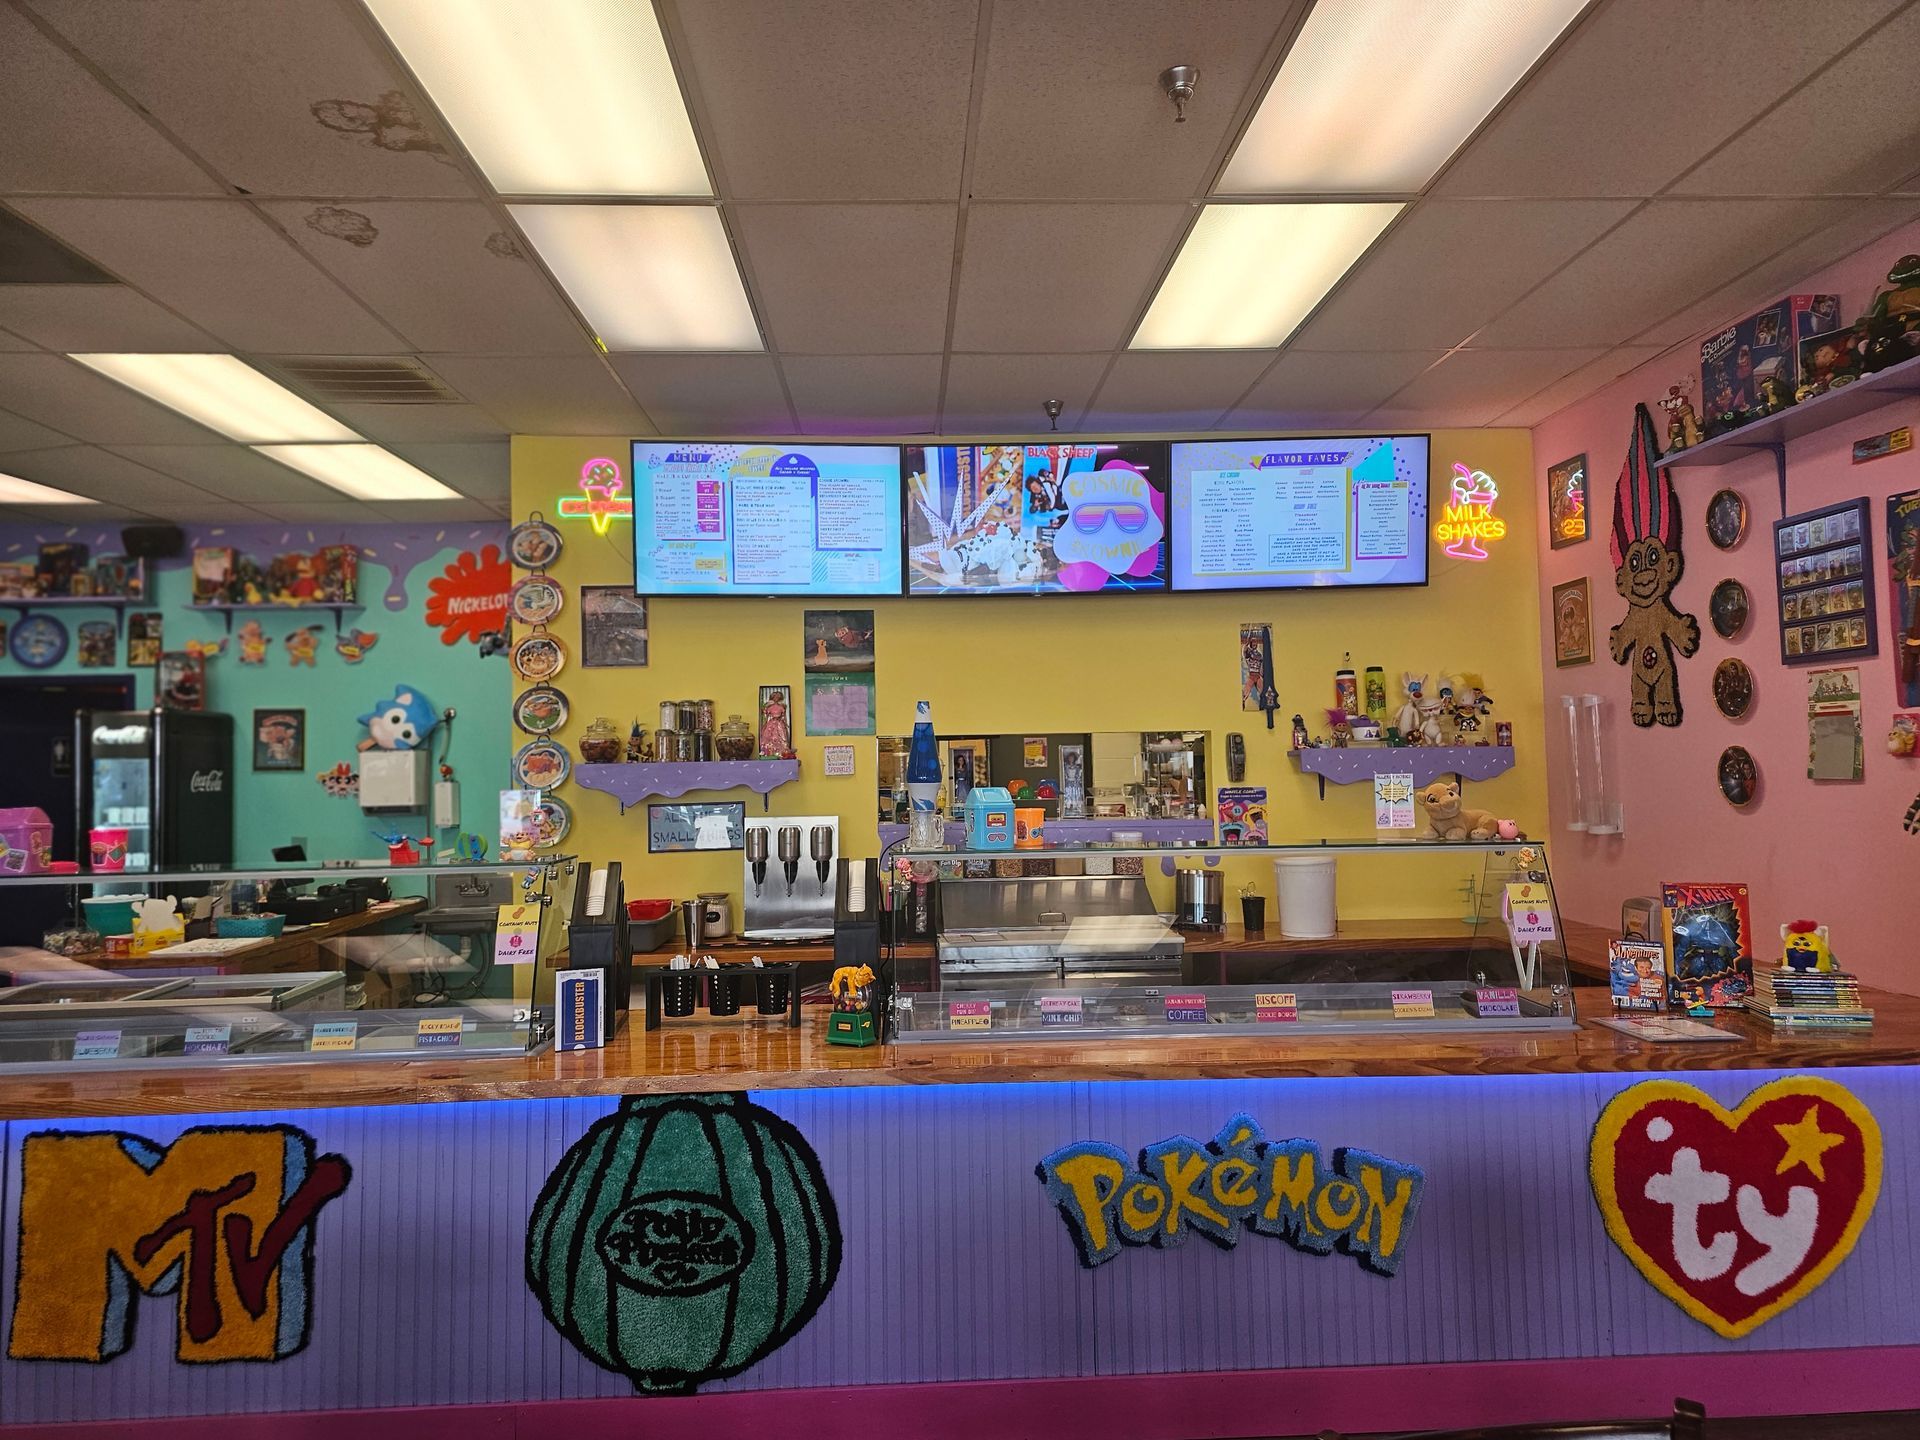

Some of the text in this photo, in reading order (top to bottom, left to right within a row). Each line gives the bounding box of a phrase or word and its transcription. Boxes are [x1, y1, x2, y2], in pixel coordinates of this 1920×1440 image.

[1701, 327, 1736, 363] Barbie
[673, 453, 703, 463] MENU
[1028, 447, 1095, 459] BLACK SHEEP
[1266, 454, 1339, 464] FLAVOR FAVES
[1069, 474, 1145, 497] COSMIC
[1446, 504, 1493, 522] MILK
[1437, 521, 1505, 540] SHAKES
[653, 831, 694, 843] SMALL
[952, 859, 962, 868] Dip
[1680, 887, 1735, 906] X-MEN
[1256, 995, 1294, 1005] BISCOFF
[1478, 990, 1516, 999] VANILLA
[575, 981, 585, 1041] BLOCKBUSTER
[1168, 1010, 1204, 1020] COFFEE
[952, 1018, 983, 1026] PINEAPPLE
[1043, 1013, 1061, 1022] MINT
[418, 1035, 453, 1043] PISTACHIO
[622, 1208, 727, 1242] Polly
[1645, 1146, 1820, 1298] ty
[8, 1124, 352, 1362] MTV
[605, 1232, 741, 1267] Pocket
